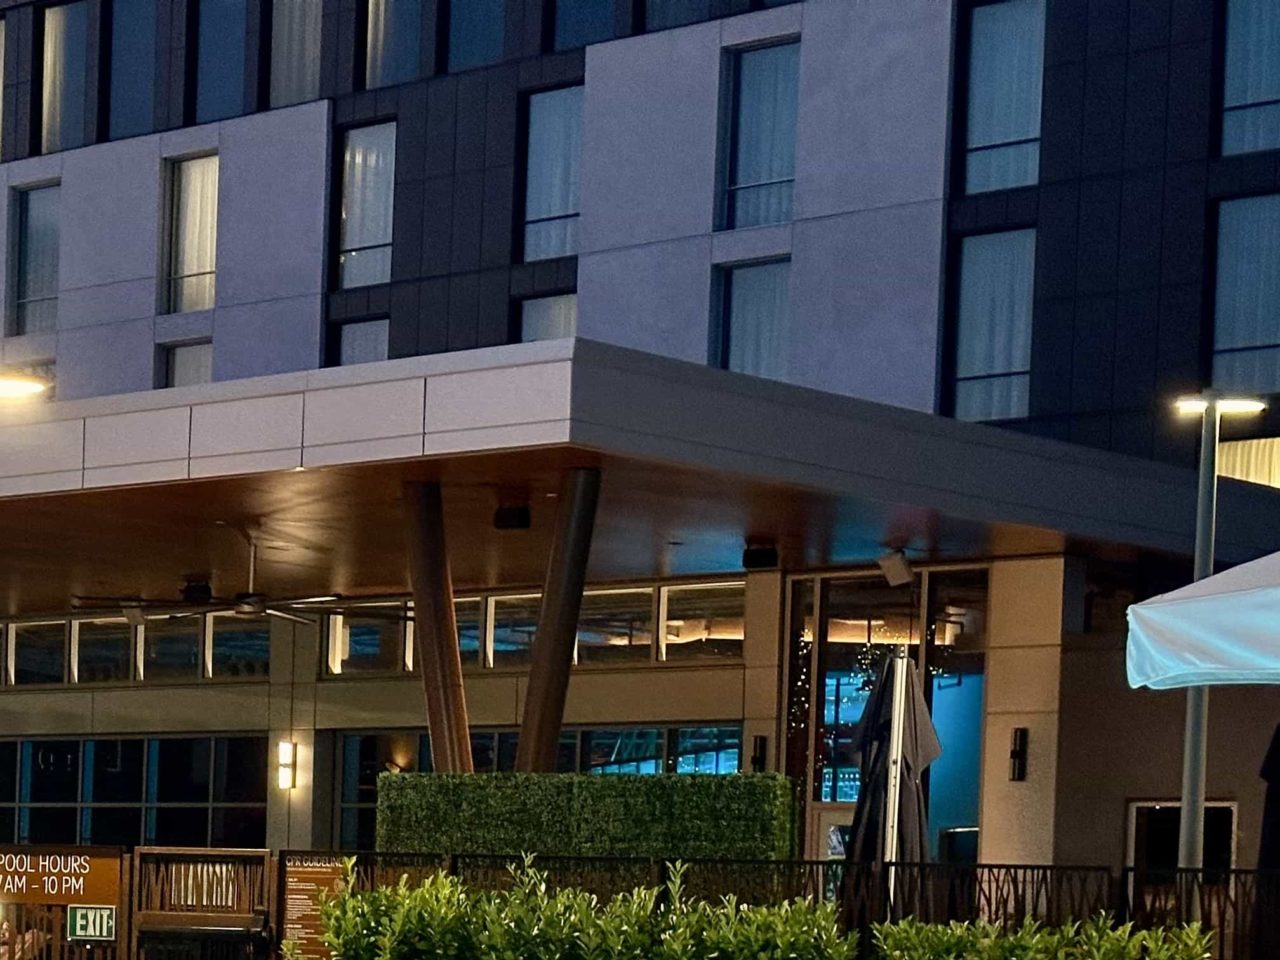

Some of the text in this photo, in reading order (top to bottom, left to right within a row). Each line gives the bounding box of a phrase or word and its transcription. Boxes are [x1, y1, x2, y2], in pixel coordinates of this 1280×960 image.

[39, 855, 90, 874] HOURS
[42, 876, 58, 894] 10
[62, 876, 84, 895] PM
[76, 908, 110, 936] EXIT
